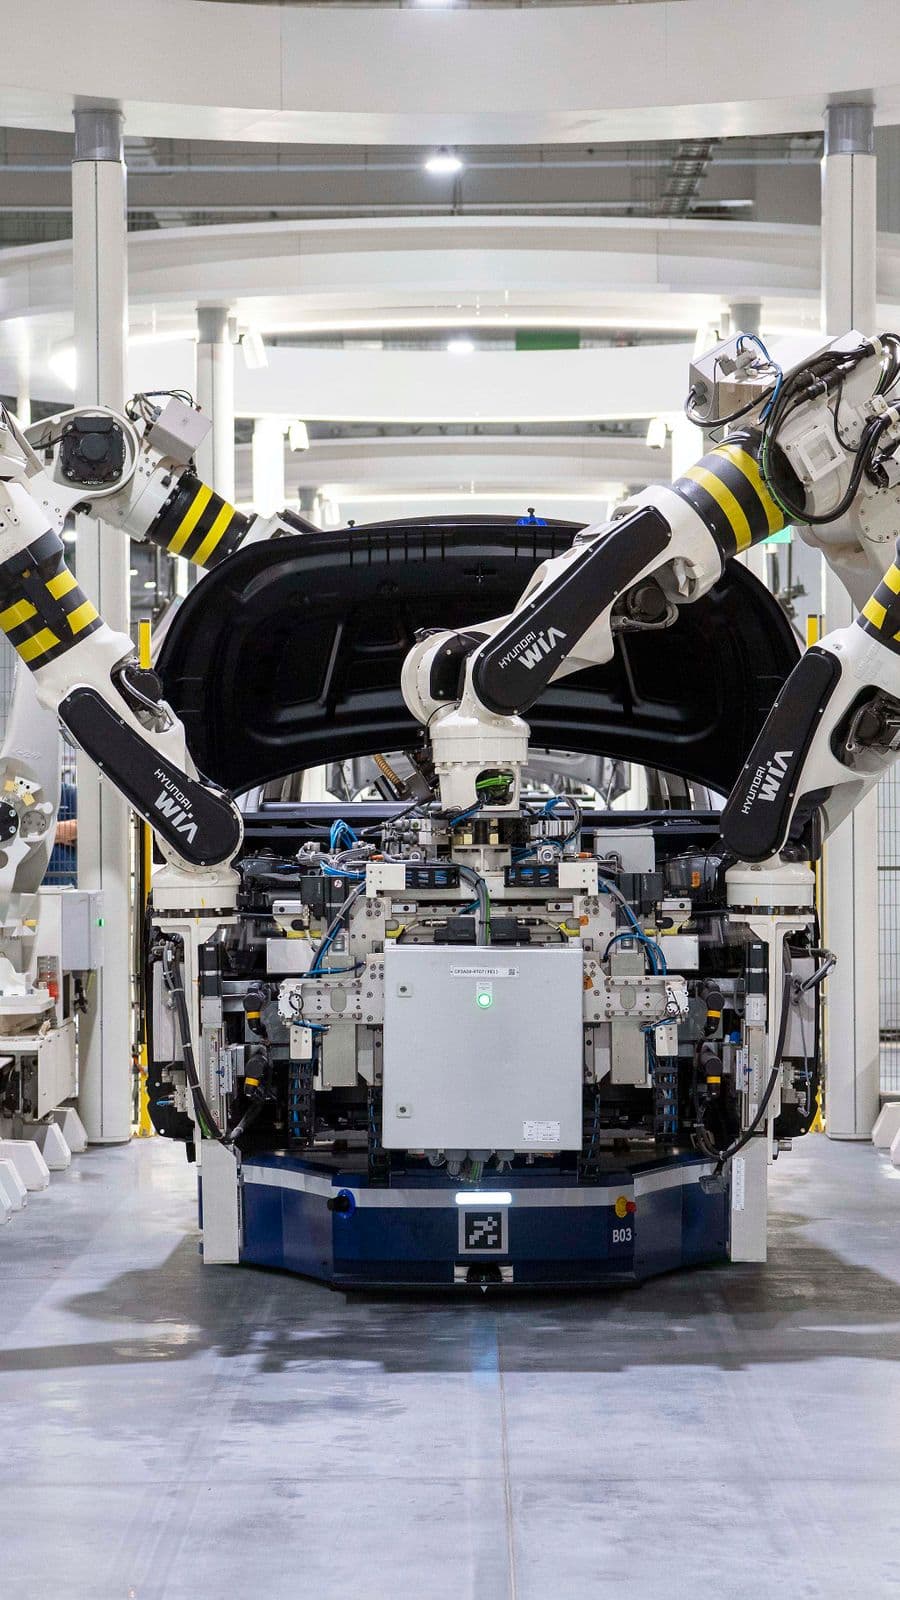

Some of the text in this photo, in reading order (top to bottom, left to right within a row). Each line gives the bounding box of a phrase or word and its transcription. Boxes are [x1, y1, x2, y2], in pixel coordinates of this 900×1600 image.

[498, 631, 537, 669] HYUNDAI
[154, 768, 192, 810] HYUNDAI
[741, 765, 766, 814] HYUNDAI
[612, 1227, 632, 1243] B03
